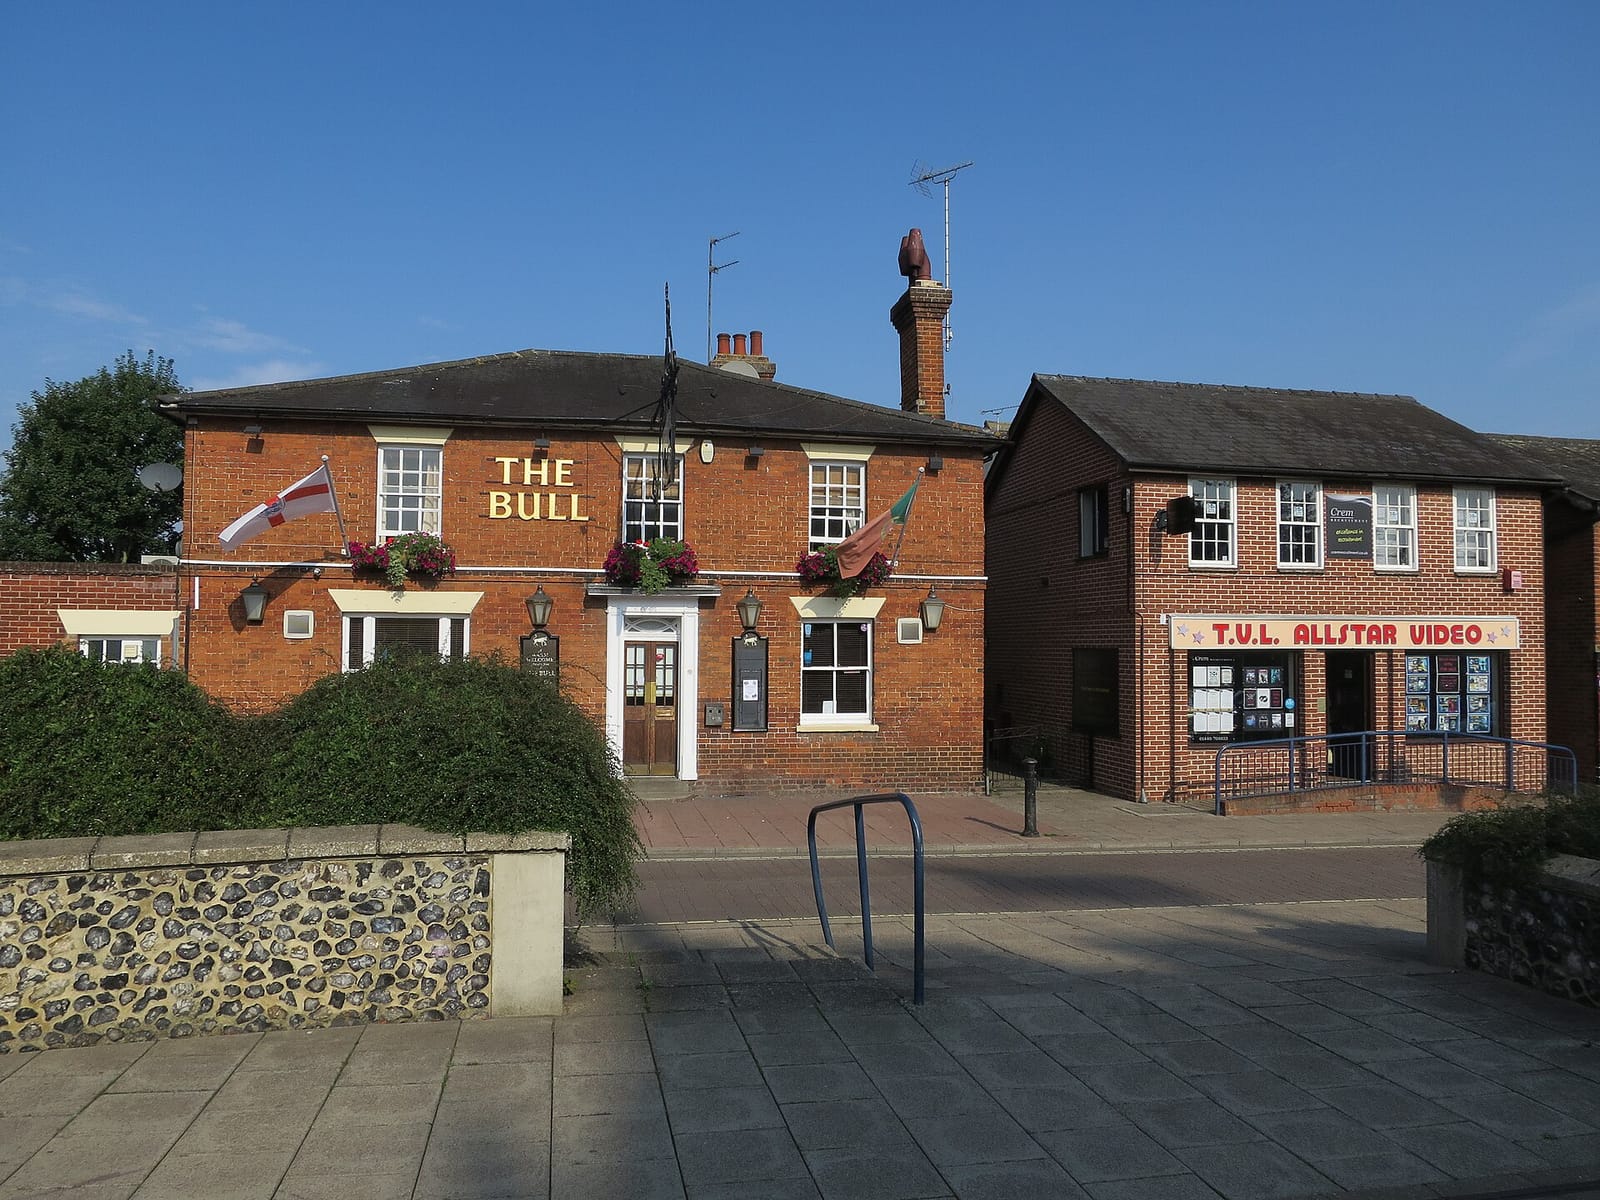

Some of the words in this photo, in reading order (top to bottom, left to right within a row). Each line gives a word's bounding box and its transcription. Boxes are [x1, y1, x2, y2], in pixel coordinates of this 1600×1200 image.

[495, 457, 574, 486] THE
[488, 490, 590, 521] BULL
[1330, 507, 1354, 517] Crem
[1212, 623, 1280, 645] T.V.L.
[1293, 623, 1397, 645] ALLSTAR
[1409, 624, 1483, 645] VIDEO
